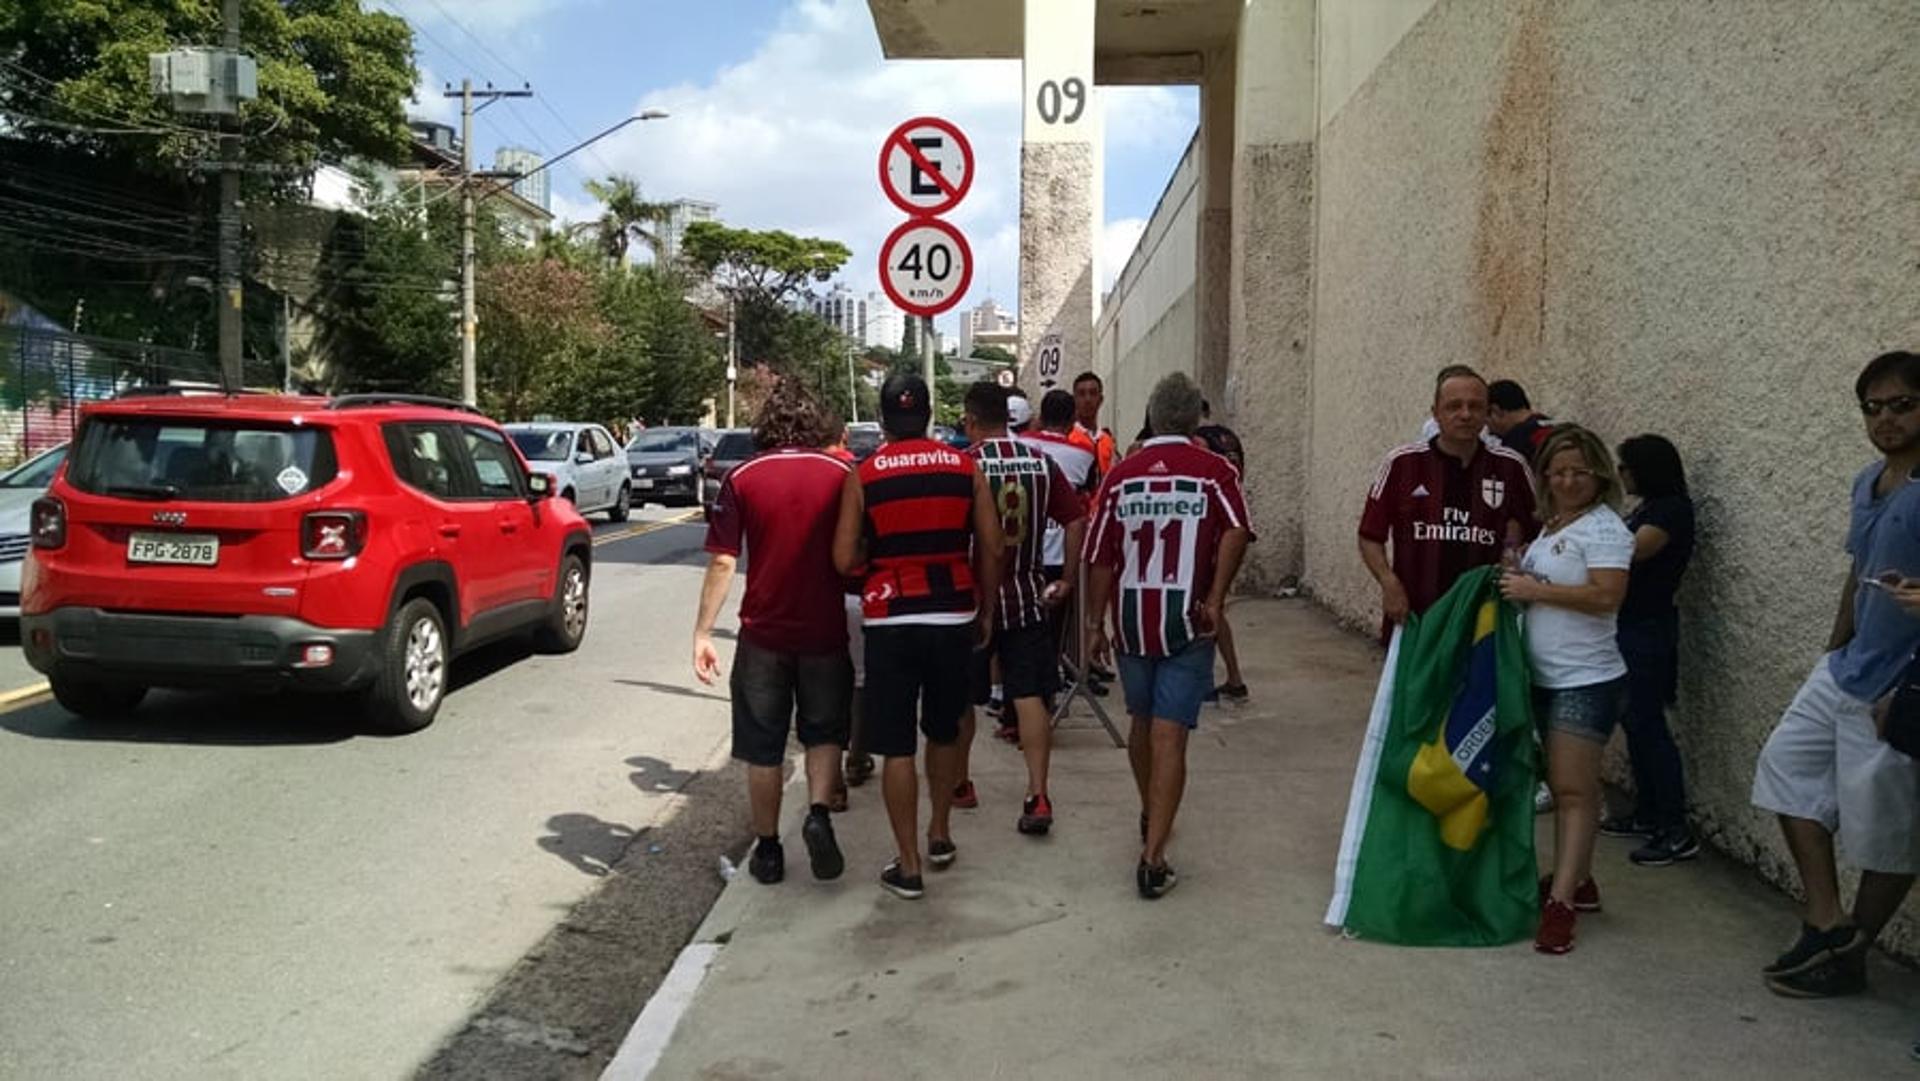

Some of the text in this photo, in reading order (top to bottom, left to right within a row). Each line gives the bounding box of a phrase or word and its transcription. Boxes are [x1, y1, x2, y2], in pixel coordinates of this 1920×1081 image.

[1036, 76, 1086, 125] 09
[911, 137, 942, 194] E
[898, 243, 952, 281] 40
[1040, 347, 1060, 376] 09
[873, 450, 961, 470] Guaravita
[1117, 494, 1205, 518] unimed
[1443, 506, 1470, 525] Fly
[1413, 521, 1496, 545] Emirates
[132, 541, 212, 561] FPG-2878
[1131, 519, 1183, 583] 11
